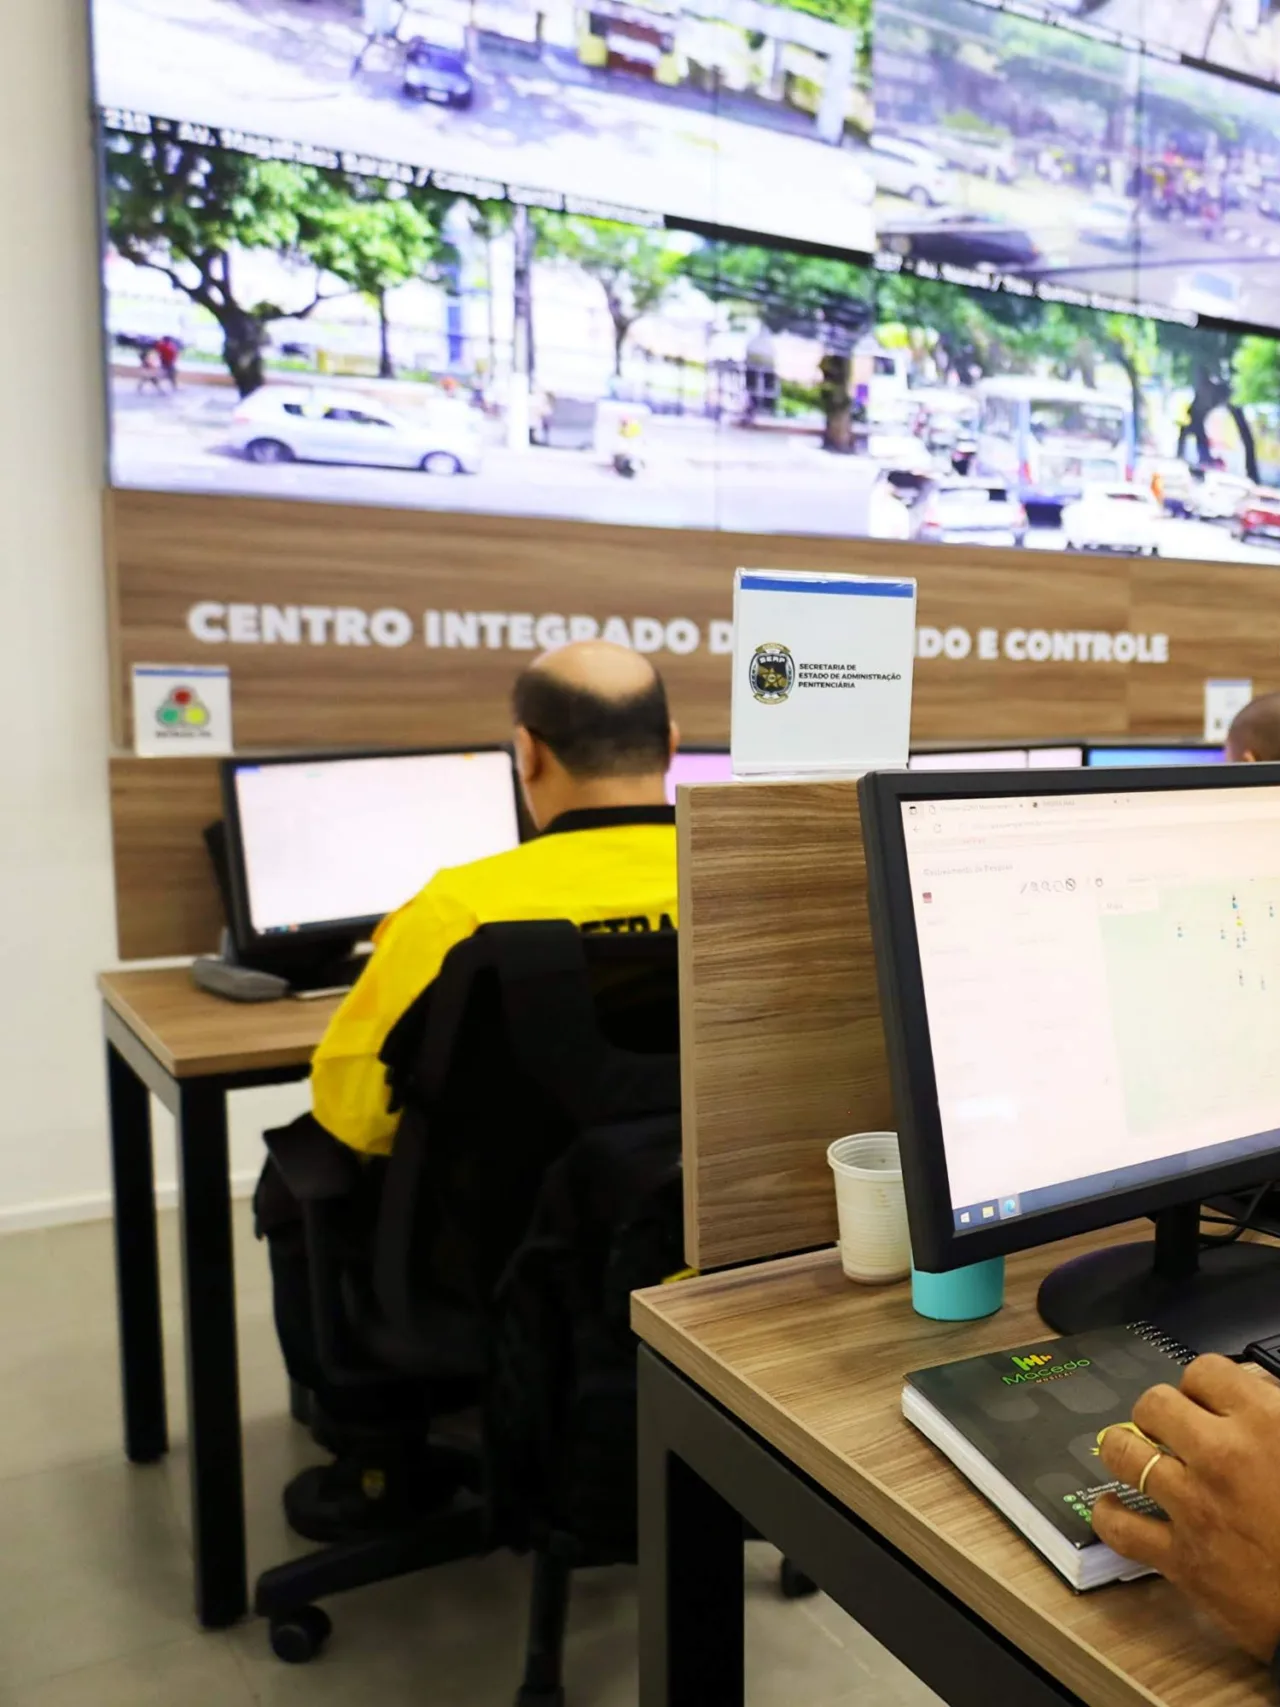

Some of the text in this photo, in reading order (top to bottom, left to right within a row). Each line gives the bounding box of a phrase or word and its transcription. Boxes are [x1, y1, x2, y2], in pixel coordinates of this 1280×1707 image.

[187, 601, 413, 648] CENTRO
[425, 609, 700, 655] INTEGRADO
[708, 619, 734, 655] D
[977, 627, 998, 660] E
[1004, 628, 1169, 663] CONTROLE
[799, 663, 845, 671] SECRETARIA
[842, 673, 901, 681] ADMINISTRAÇÃO
[1002, 1359, 1091, 1385] Macedo
